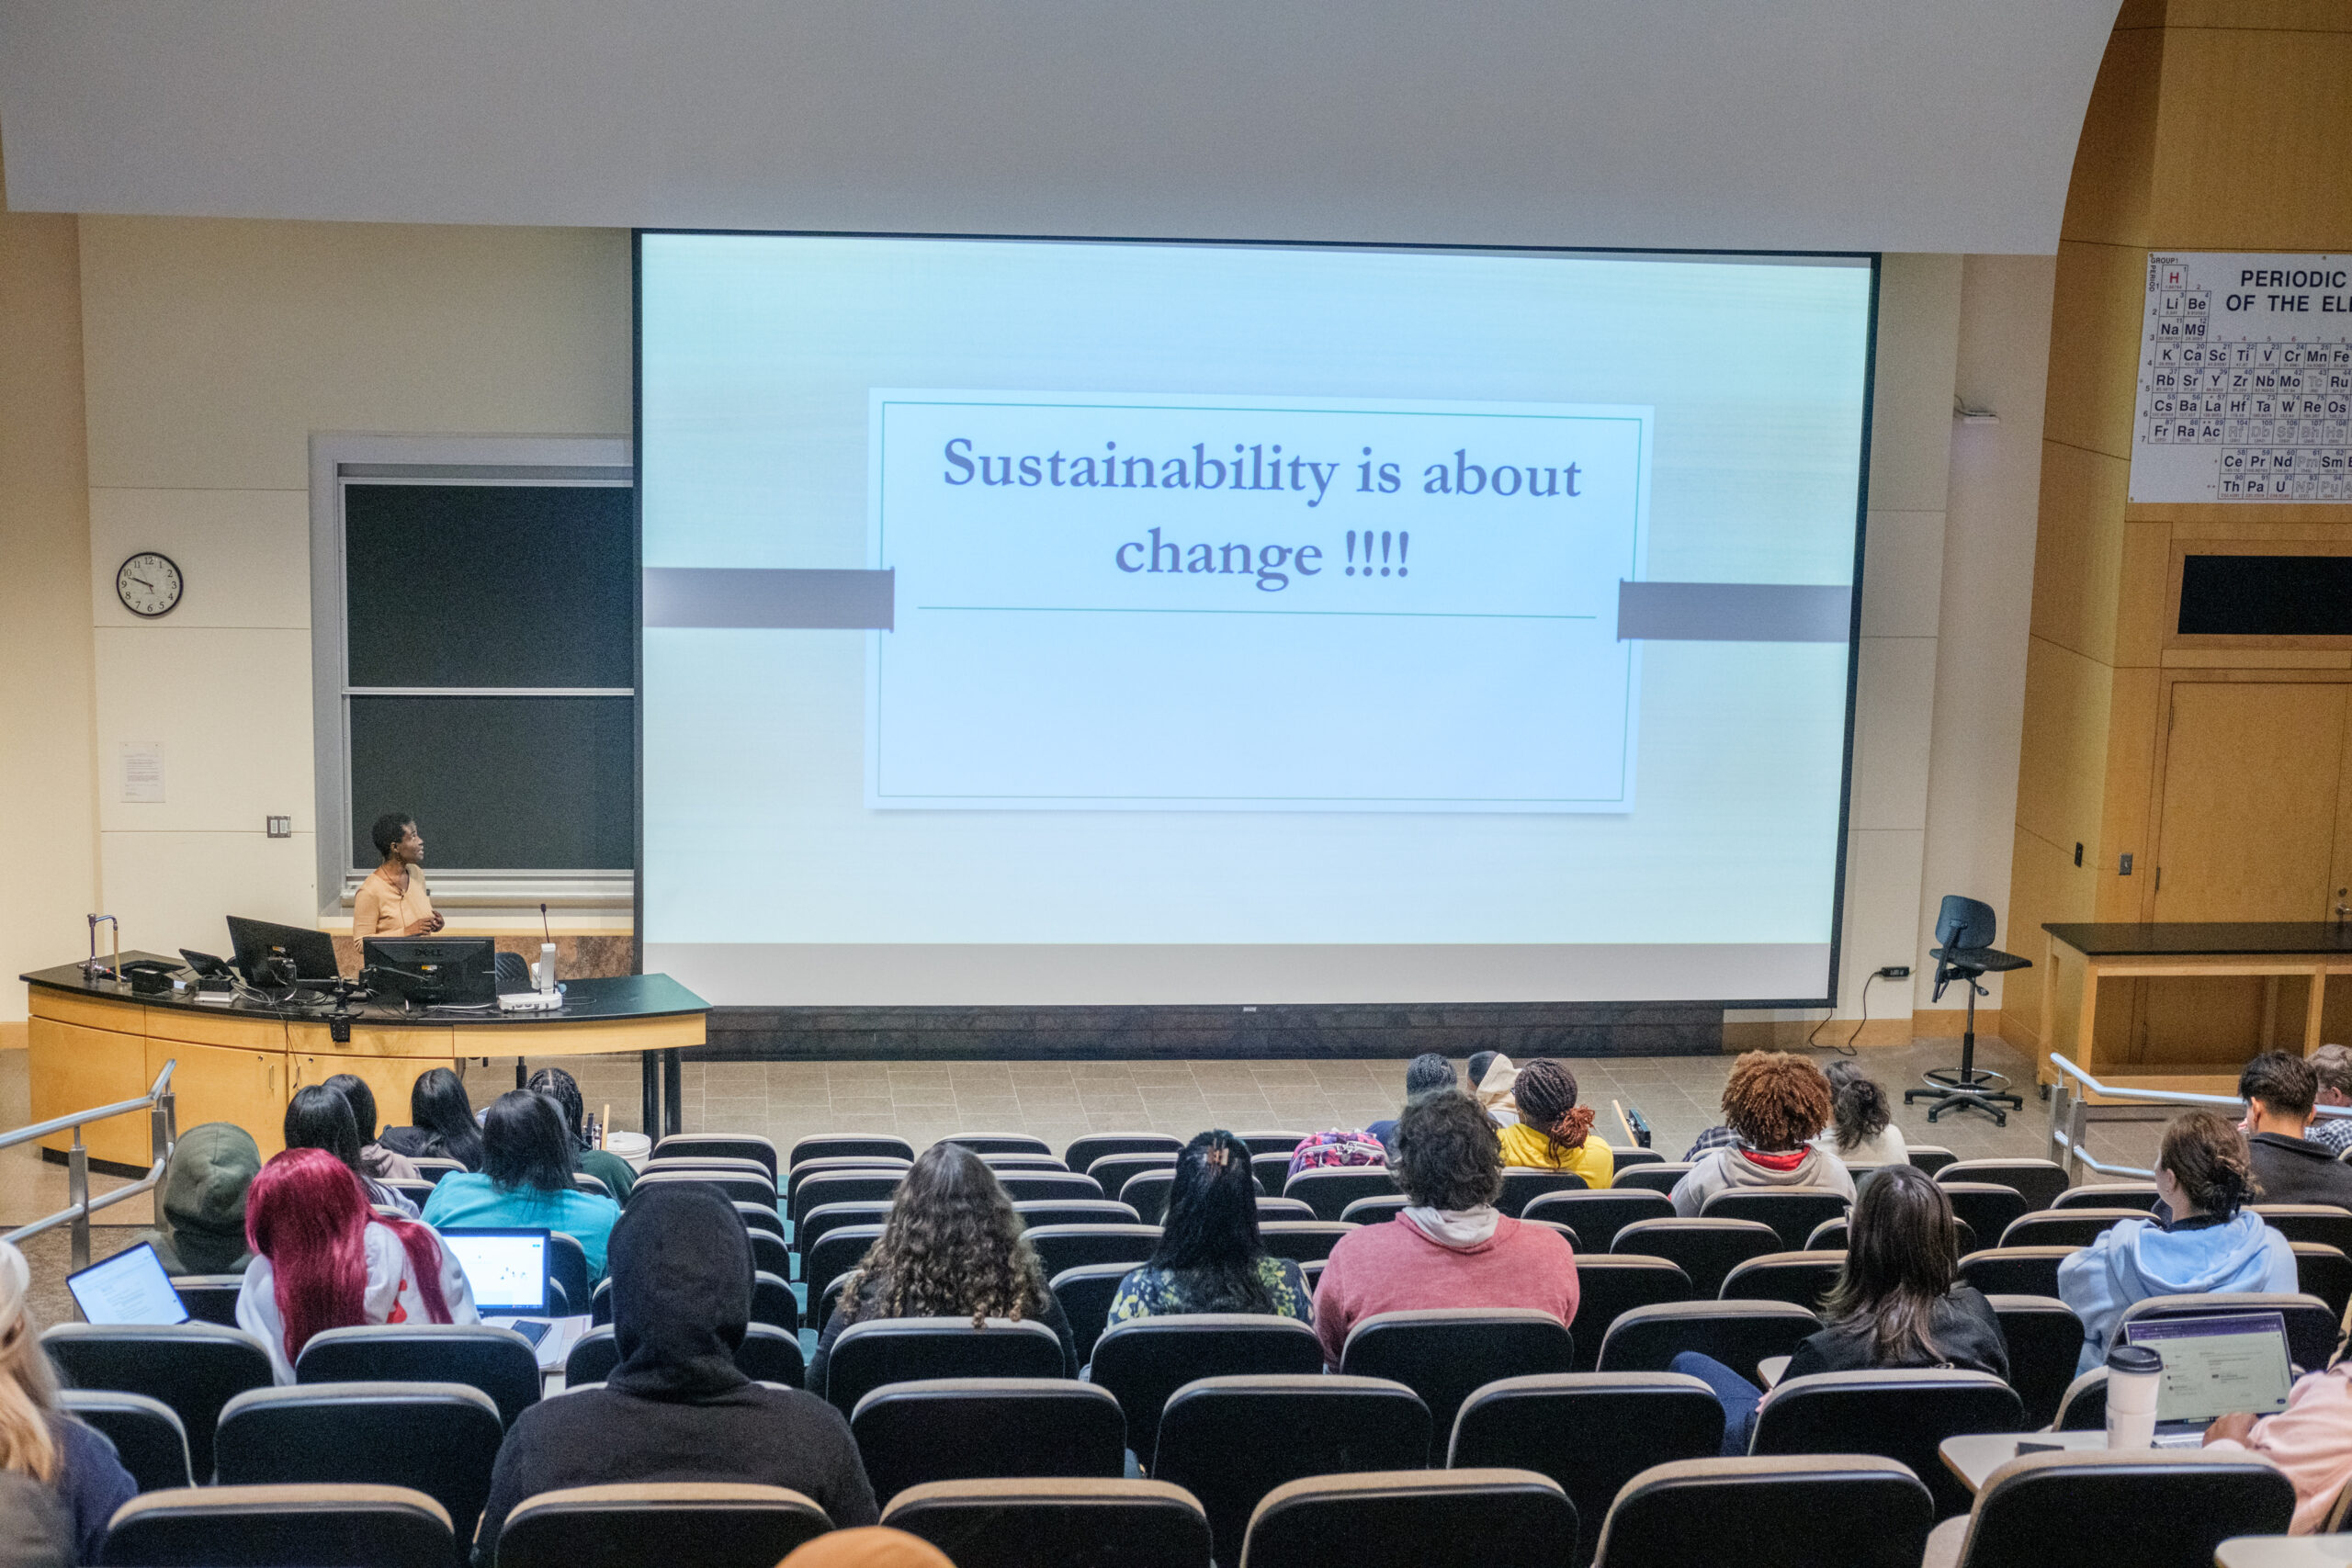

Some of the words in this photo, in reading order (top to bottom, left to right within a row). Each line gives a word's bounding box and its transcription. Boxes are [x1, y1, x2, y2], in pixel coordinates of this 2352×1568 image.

[2169, 272, 2179, 284] H
[2241, 270, 2346, 288] PERIODIC
[2166, 298, 2178, 309] Li
[2188, 299, 2206, 310] Be
[2226, 294, 2256, 311] OF
[2267, 295, 2310, 311] THE
[2322, 296, 2352, 312] EL
[2161, 323, 2178, 335] Na
[2185, 323, 2205, 336] Mg
[2163, 349, 2172, 360] K
[2184, 349, 2202, 361] Ca
[2210, 350, 2226, 361] Sc
[2237, 350, 2249, 362] Ti
[2264, 350, 2272, 361] V
[2285, 350, 2301, 362] Cr
[2307, 351, 2327, 362] Mn
[2334, 351, 2349, 362] Fe
[2156, 375, 2175, 386] Rb
[2183, 375, 2198, 386] Sr
[2212, 375, 2221, 386] Y
[2233, 376, 2248, 387] Zr
[2256, 376, 2275, 386] Nb
[2279, 376, 2301, 387] Mo
[2331, 376, 2348, 388] Ru
[2154, 400, 2173, 412] Cs
[2179, 400, 2197, 412] Ba
[2206, 400, 2222, 412] La
[2230, 400, 2245, 412] Hf
[2256, 401, 2270, 412] Ta
[2282, 401, 2295, 412] W
[2303, 401, 2322, 412] Re
[2328, 401, 2346, 412] Os
[2154, 425, 2168, 436] Fr
[2177, 425, 2195, 436] Ra
[2202, 426, 2221, 437] Ac
[2224, 456, 2243, 467] Ce
[2251, 456, 2266, 467] Pr
[2274, 457, 2292, 467] Nd
[2322, 457, 2342, 468] Sm
[944, 437, 1340, 508] Sustainability
[1357, 447, 1402, 494] is
[1423, 449, 1582, 497] about
[2223, 481, 2240, 491] Th
[2248, 481, 2264, 492] Pa
[2276, 481, 2285, 492] U
[144, 557, 154, 565] 12
[1115, 527, 1322, 592] change
[1345, 530, 1410, 577] !!!!
[123, 569, 132, 577] 10
[167, 570, 173, 578] 2
[172, 581, 176, 589] 3
[125, 592, 131, 600] 8
[135, 601, 141, 609] 7
[147, 604, 153, 612] 6
